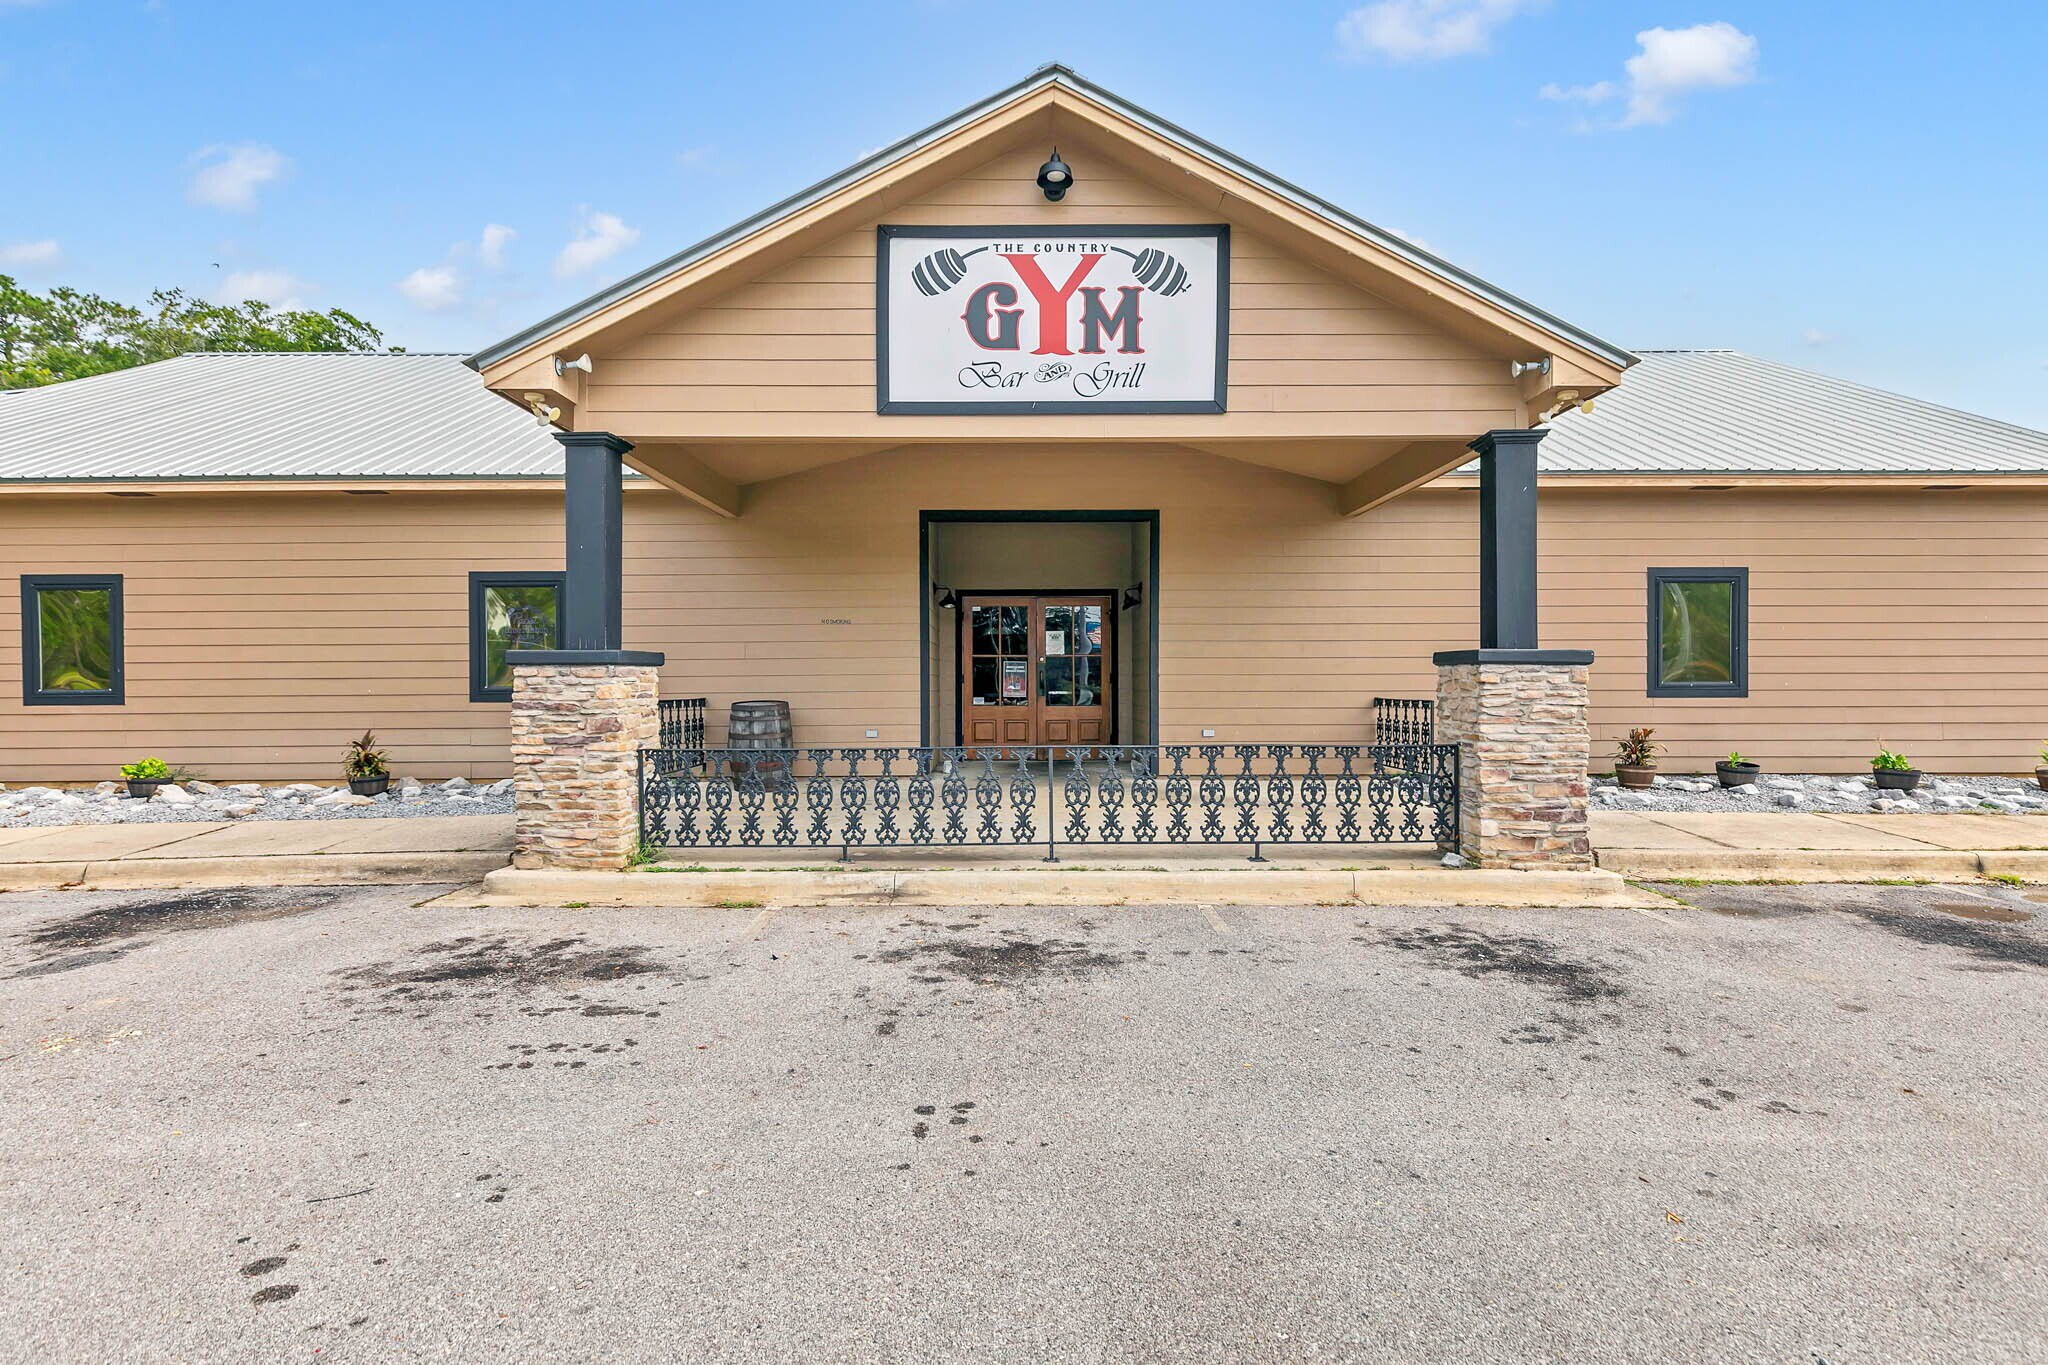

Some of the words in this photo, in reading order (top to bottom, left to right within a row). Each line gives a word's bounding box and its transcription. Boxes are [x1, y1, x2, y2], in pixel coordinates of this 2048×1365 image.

[993, 243, 1024, 253] THE
[1034, 243, 1109, 253] COUNTRY
[960, 254, 1145, 356] GYM
[958, 361, 1029, 388] Bar
[1039, 363, 1069, 381] AND
[1073, 361, 1146, 397] Grill
